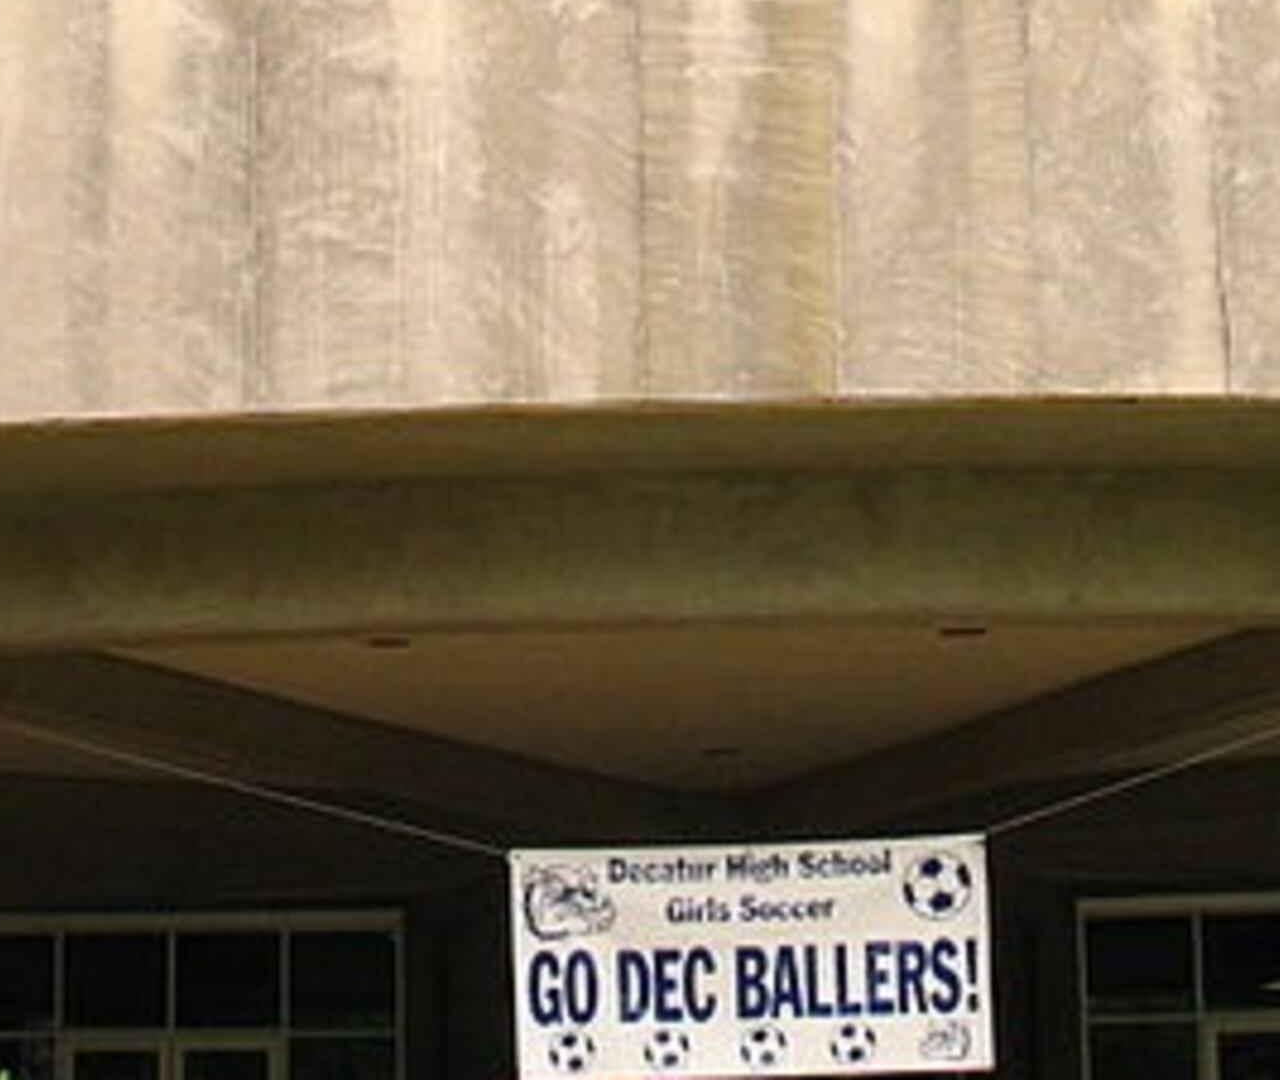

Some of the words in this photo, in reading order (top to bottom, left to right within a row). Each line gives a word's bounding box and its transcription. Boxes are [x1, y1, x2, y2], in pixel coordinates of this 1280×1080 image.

[607, 855, 715, 883] Decatur
[726, 852, 789, 883] High
[798, 849, 892, 880] School
[666, 896, 732, 924] Girls
[738, 895, 835, 922] Soccer
[528, 949, 598, 1026] GO
[619, 946, 717, 1023] DEC
[735, 938, 979, 1020] BALLERS!
